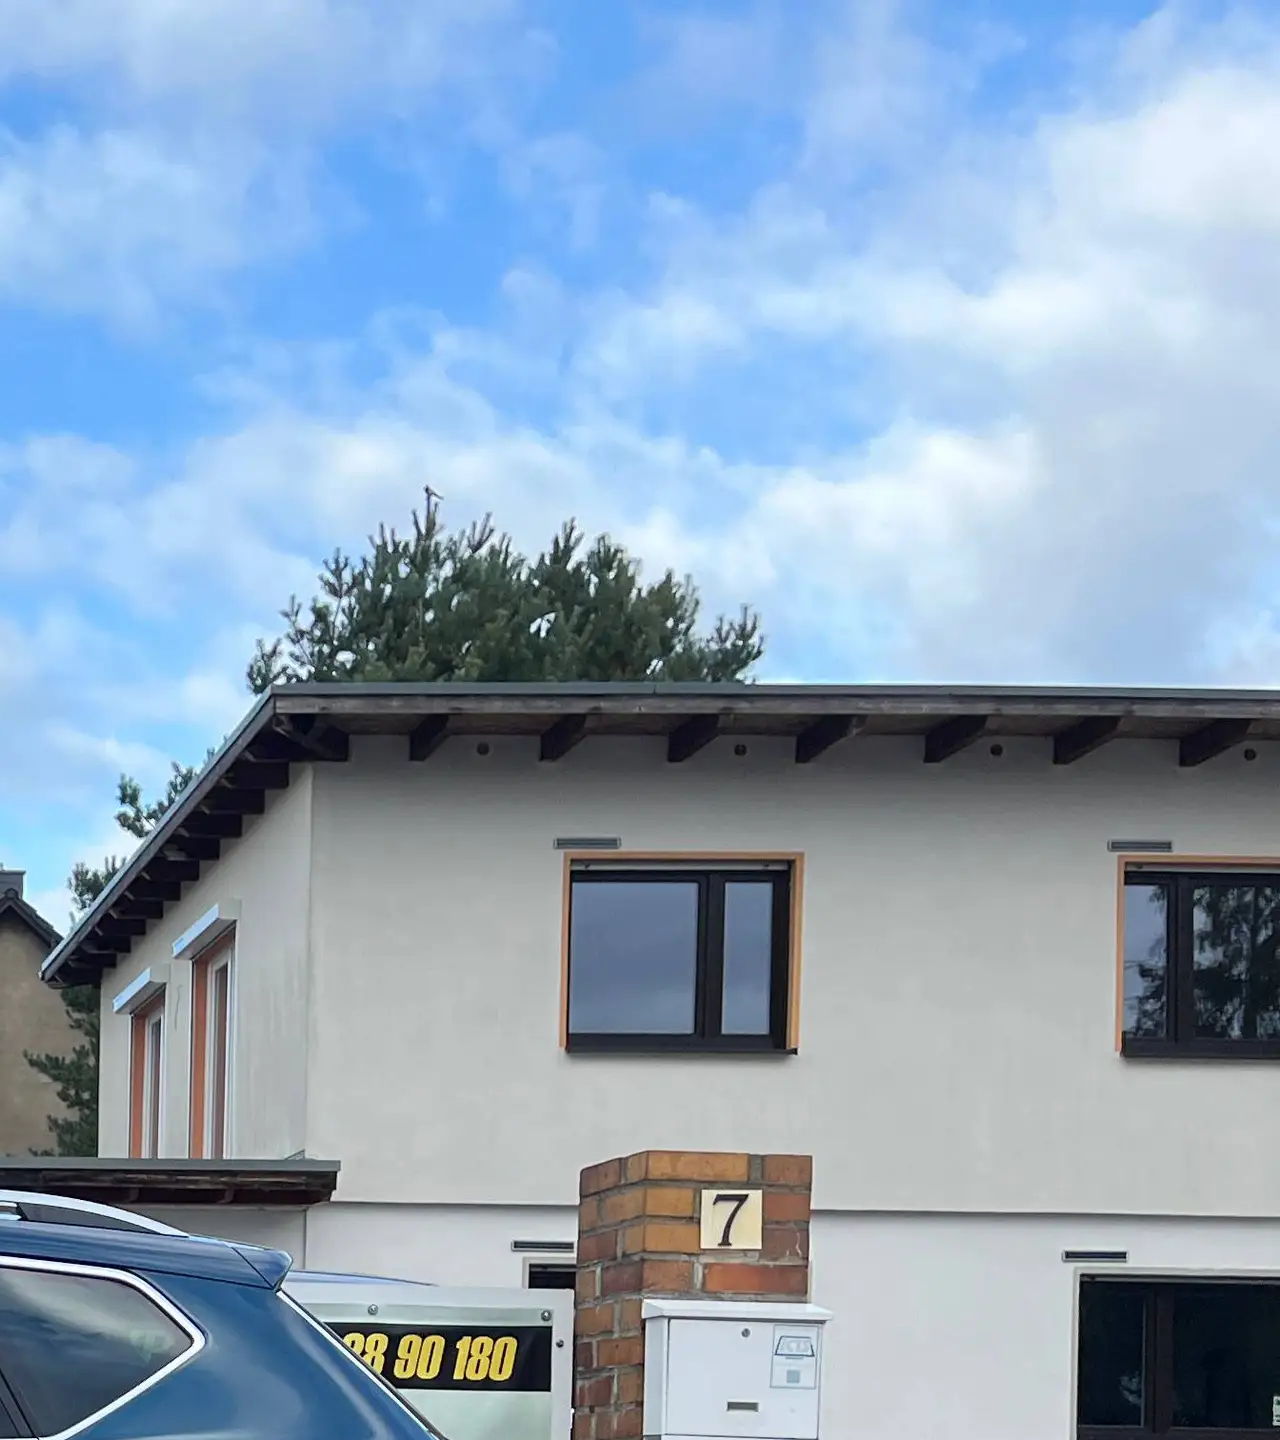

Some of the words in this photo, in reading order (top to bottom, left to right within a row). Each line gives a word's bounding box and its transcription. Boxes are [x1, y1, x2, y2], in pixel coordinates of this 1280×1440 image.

[712, 1193, 749, 1247] 7
[393, 1334, 445, 1380] 90
[452, 1336, 518, 1381] 180
